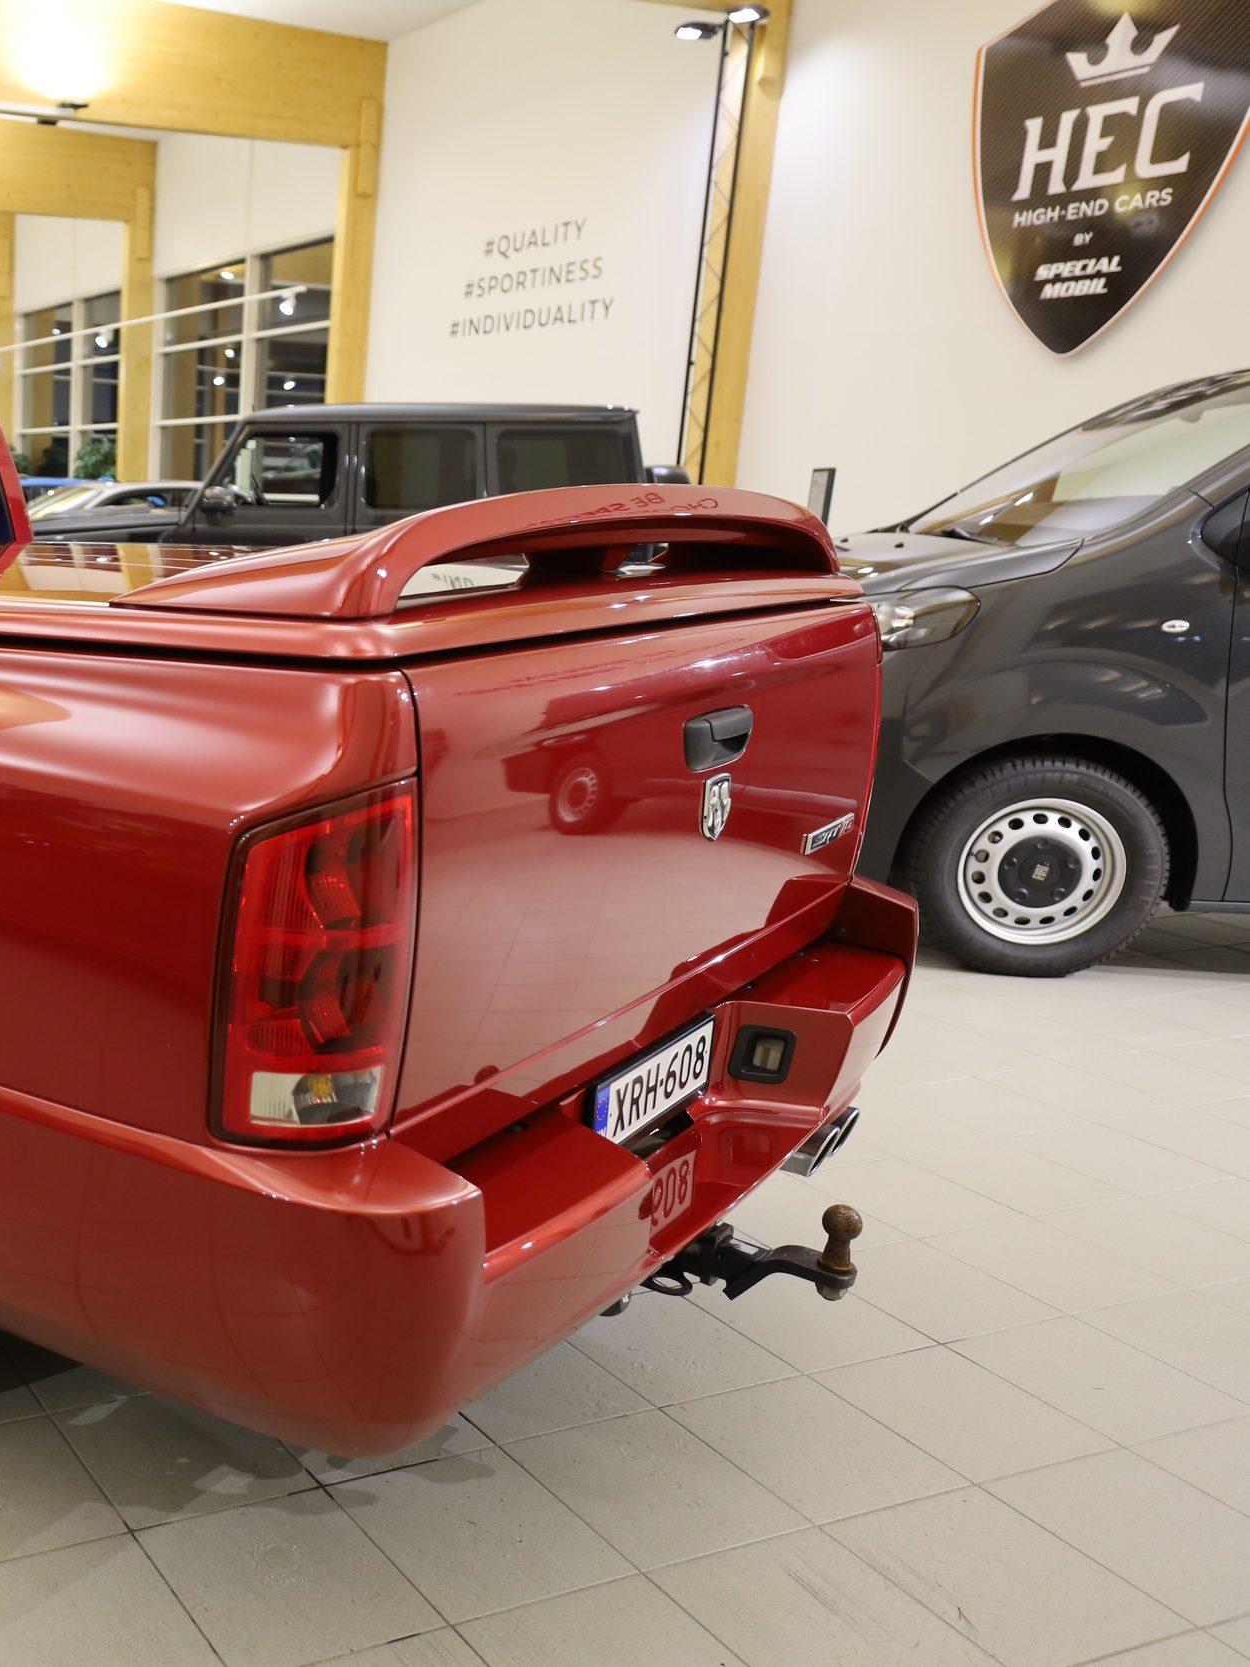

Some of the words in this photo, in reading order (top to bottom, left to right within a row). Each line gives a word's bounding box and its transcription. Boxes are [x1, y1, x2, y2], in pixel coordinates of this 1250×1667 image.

[1011, 82, 1204, 201] HEC
[1114, 188, 1173, 213] CARS
[484, 218, 587, 259] #QUALITY
[1073, 232, 1093, 246] BY
[464, 256, 603, 299] #SPORTINESS
[1034, 255, 1122, 281] SPECIAL
[1040, 277, 1108, 300] MOBIL
[450, 297, 615, 338] #INDIVIDUALITY
[612, 1034, 707, 1138] XRH-608
